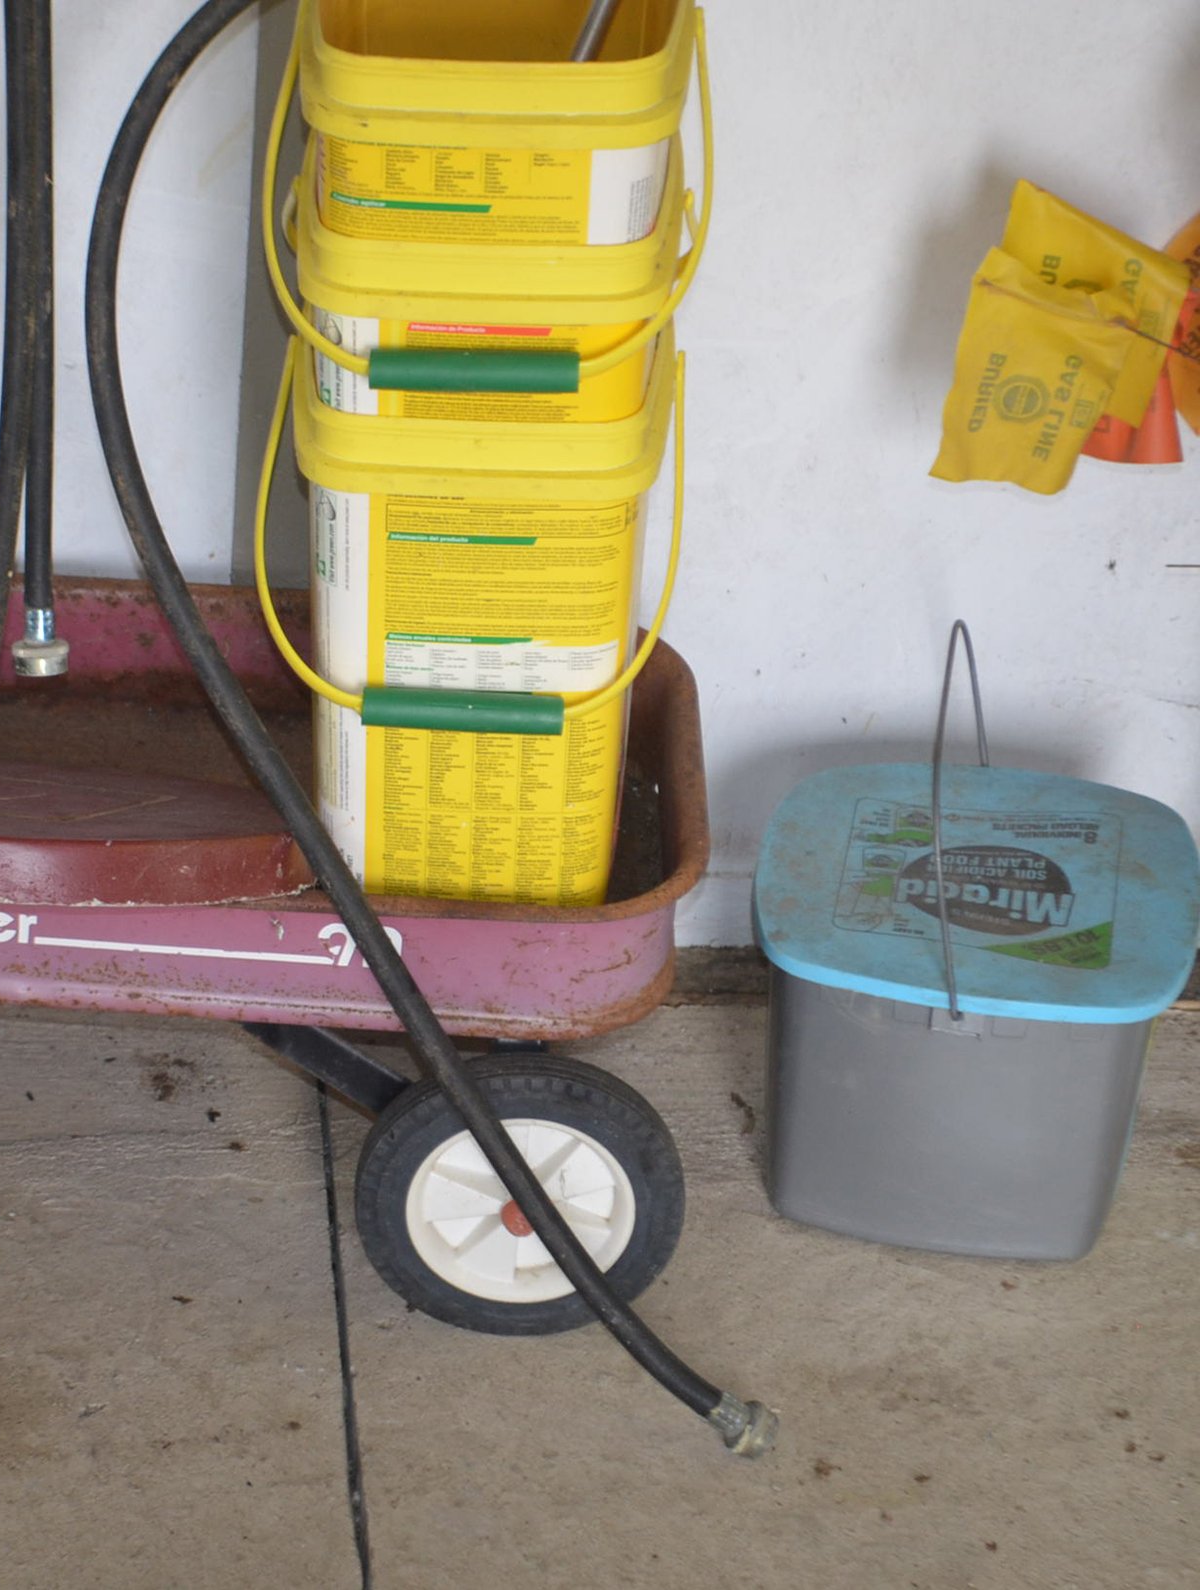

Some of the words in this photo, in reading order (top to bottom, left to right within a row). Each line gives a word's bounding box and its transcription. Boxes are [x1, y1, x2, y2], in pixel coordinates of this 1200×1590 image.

[1083, 831, 1099, 845] 8
[984, 856, 1047, 870] PLANT
[1011, 868, 1048, 881] SOIL
[895, 877, 1075, 928] Miracid
